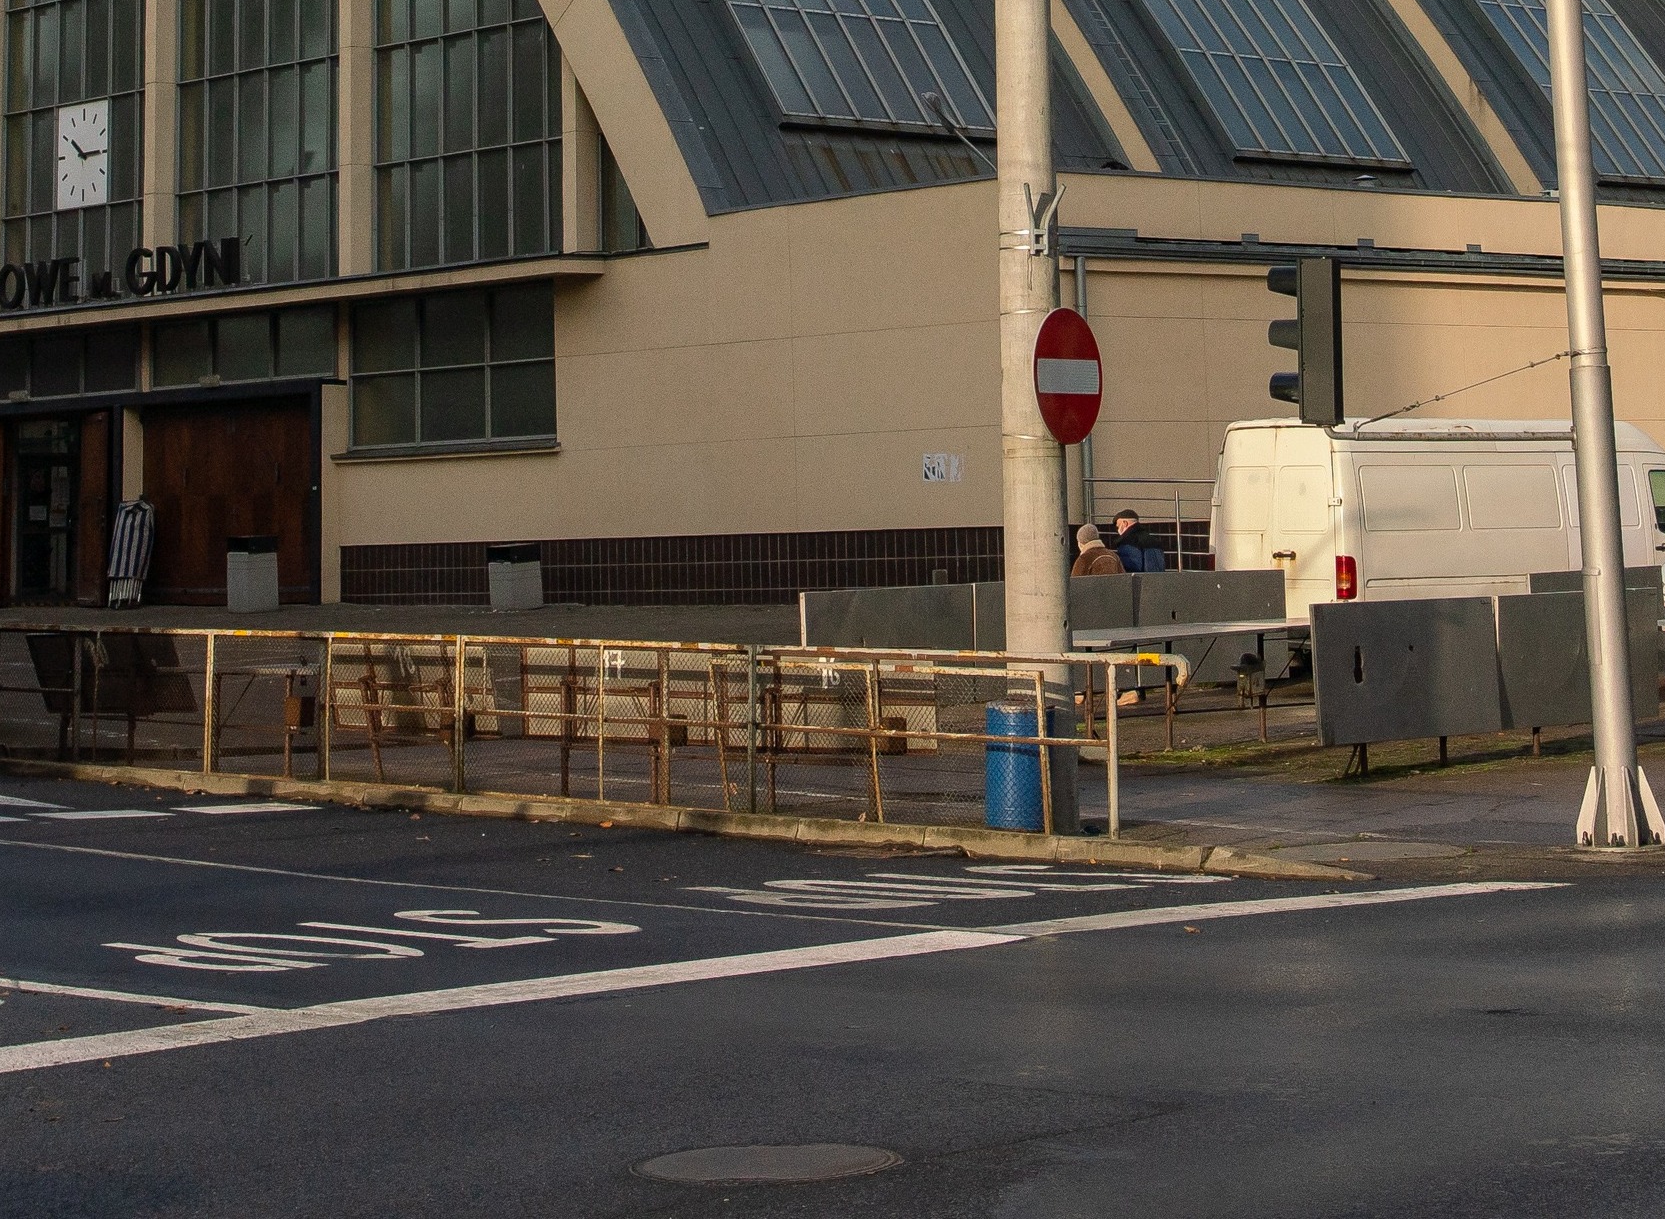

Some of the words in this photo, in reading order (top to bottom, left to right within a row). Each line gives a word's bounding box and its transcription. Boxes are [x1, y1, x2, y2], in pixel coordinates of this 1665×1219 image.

[125, 236, 241, 297] GDYNI
[679, 864, 1236, 910] STOP
[100, 909, 644, 973] STOP
